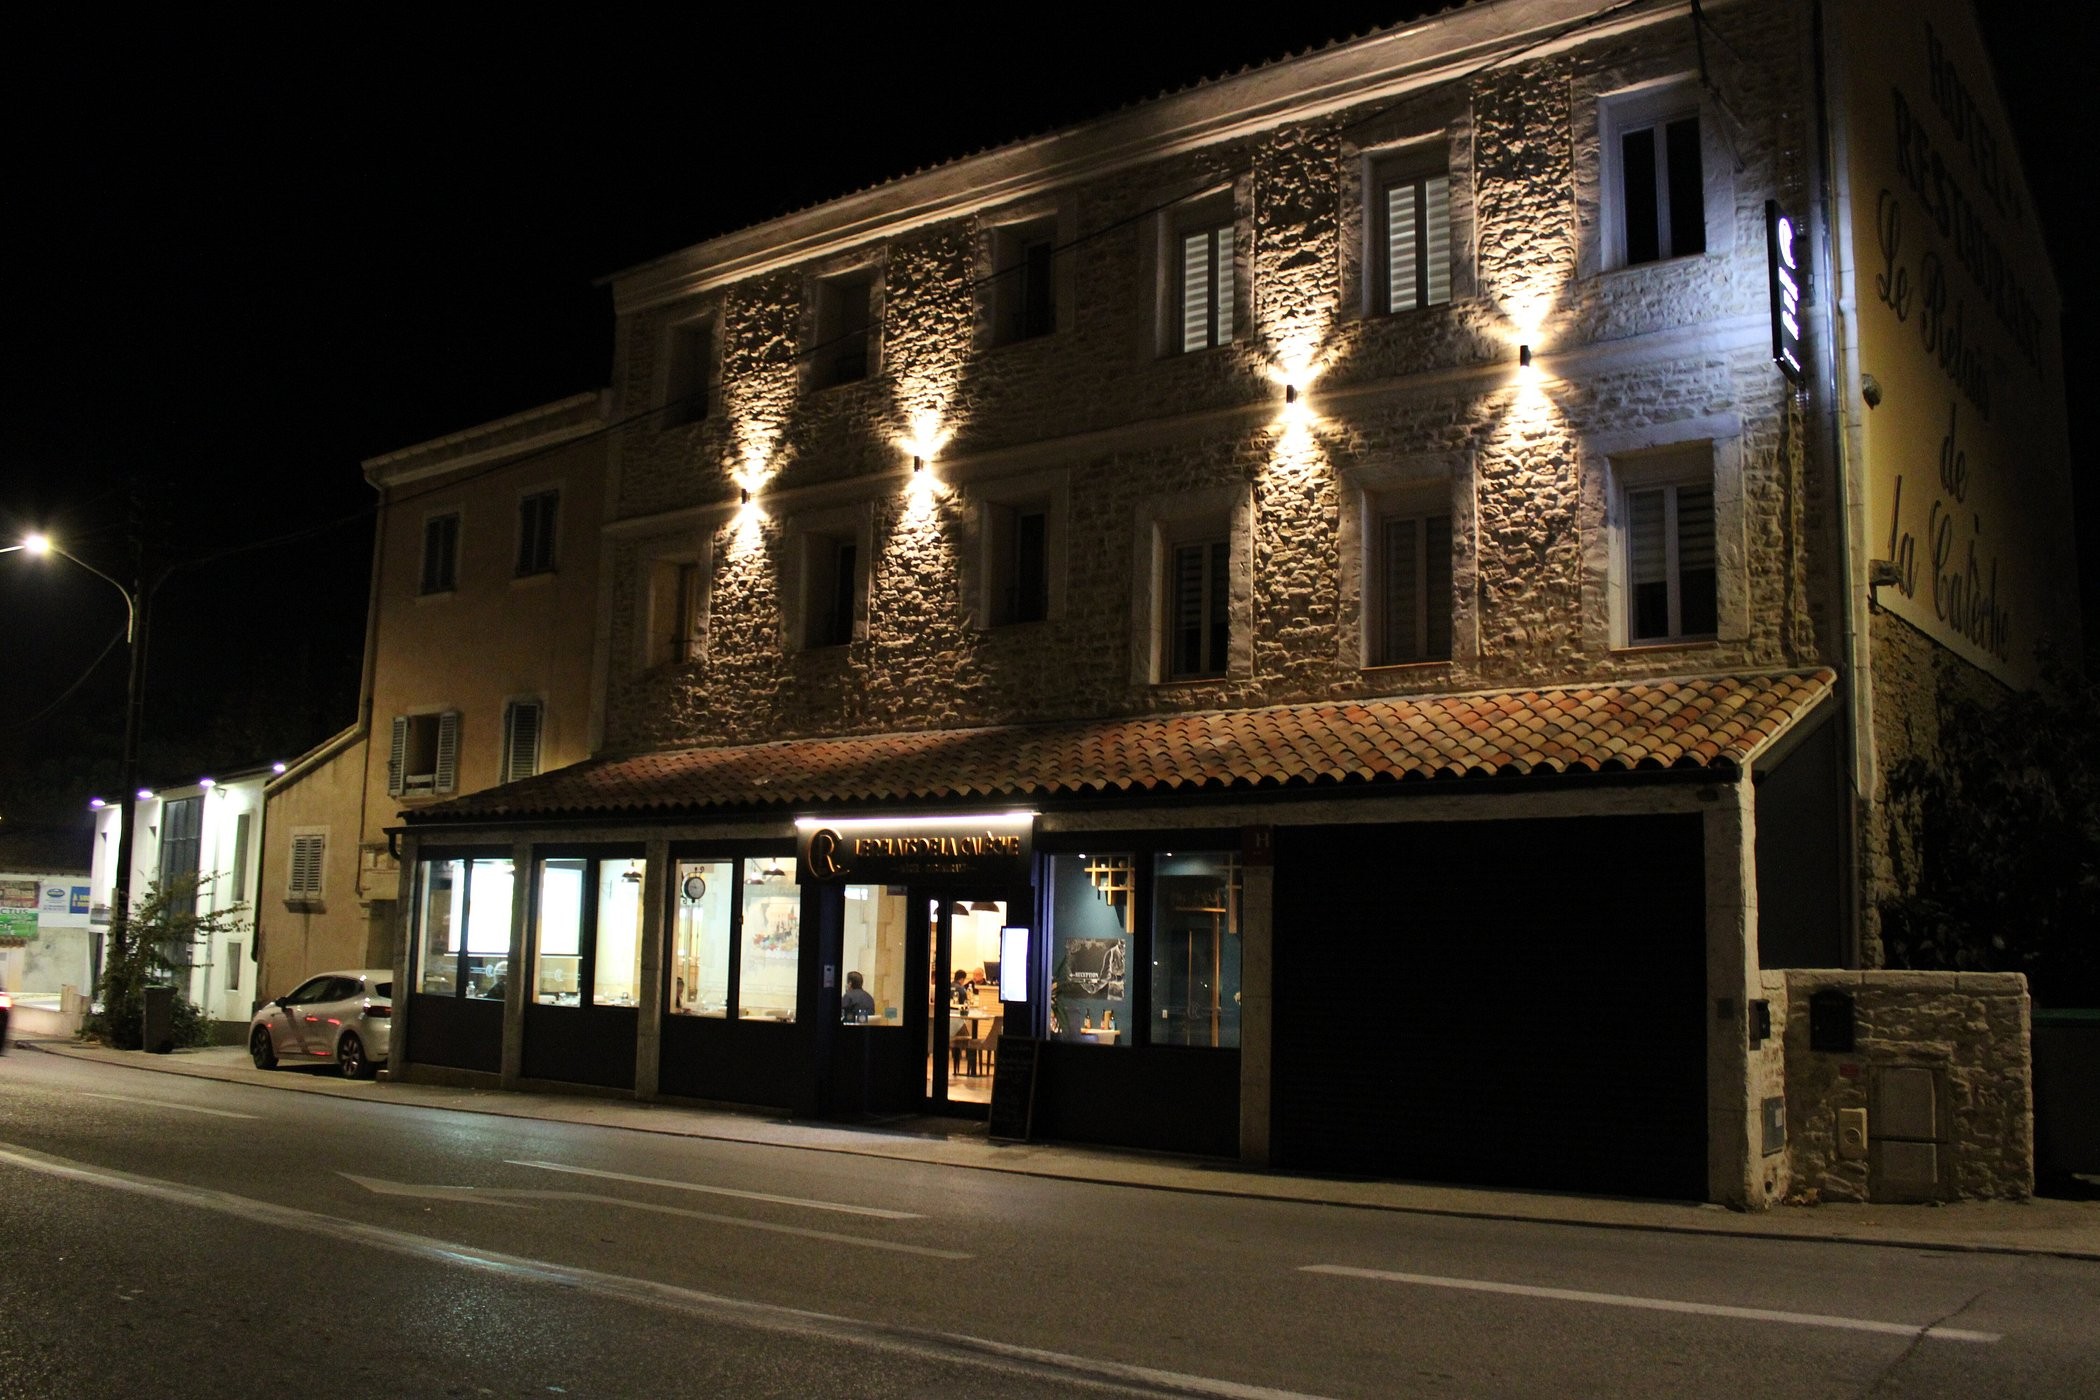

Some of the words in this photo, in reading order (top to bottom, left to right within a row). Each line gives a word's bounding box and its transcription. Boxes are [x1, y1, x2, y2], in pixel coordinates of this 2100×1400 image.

[1876, 188, 1912, 322] Le
[1920, 252, 1990, 421] Relais
[1892, 86, 2044, 382] RESTAURANT
[1940, 402, 1970, 504] de
[855, 838, 871, 857] LE
[872, 838, 917, 857] RELAIS
[919, 837, 939, 857] DE
[941, 836, 958, 857] LA
